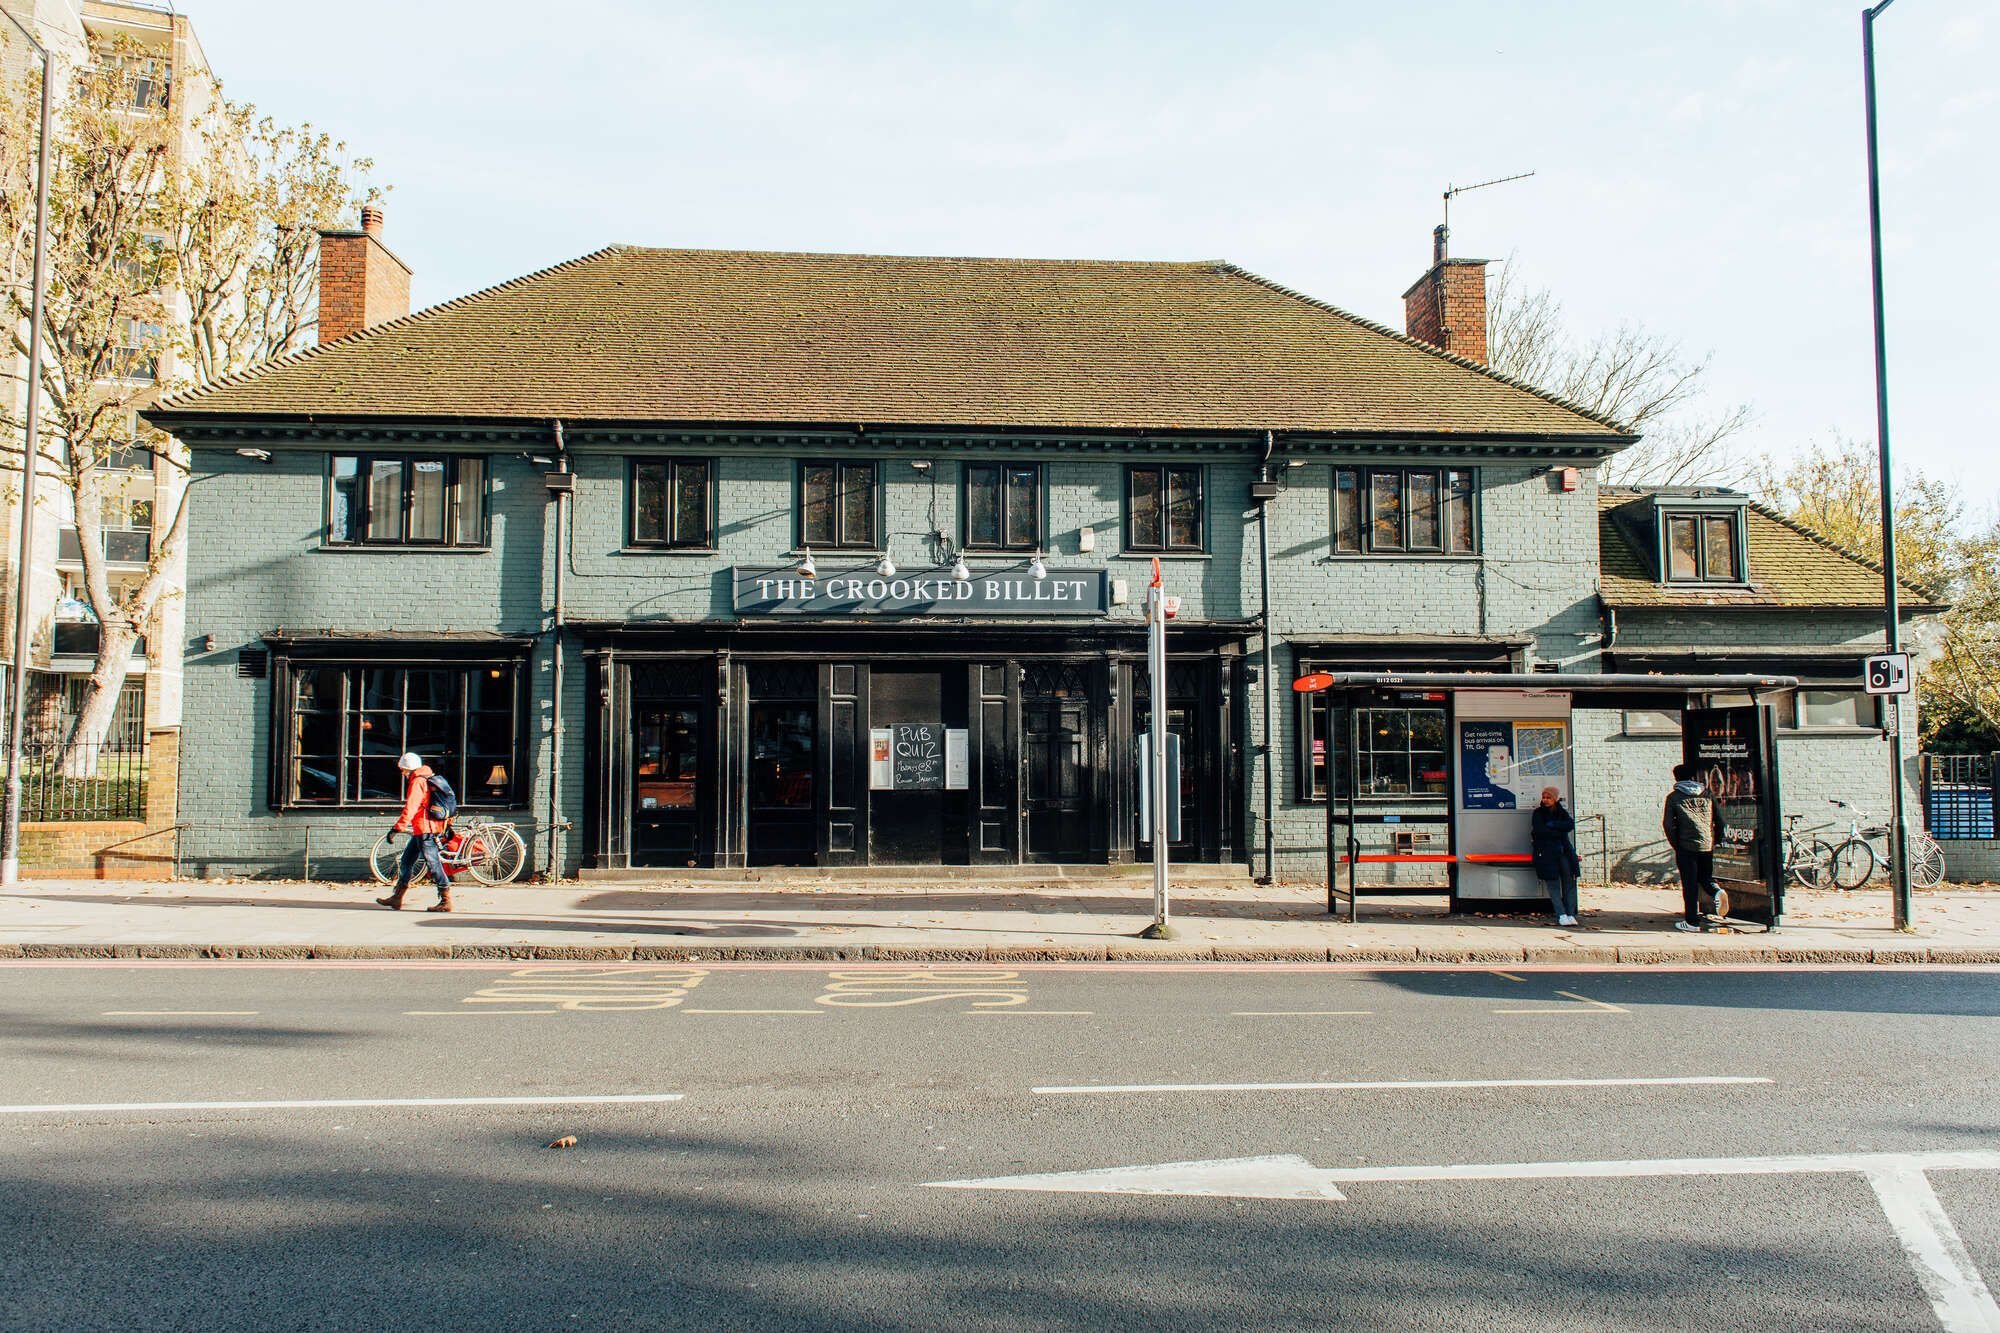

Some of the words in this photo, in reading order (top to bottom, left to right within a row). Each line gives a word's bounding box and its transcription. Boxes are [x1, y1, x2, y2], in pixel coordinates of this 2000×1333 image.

[756, 579, 815, 600] THE
[826, 579, 974, 600] CROOKED
[985, 580, 1088, 601] BILLET
[900, 727, 931, 741] PUB
[896, 742, 941, 759] QUIZ
[1723, 824, 1754, 842] Voyage
[814, 971, 1028, 1007] BUS
